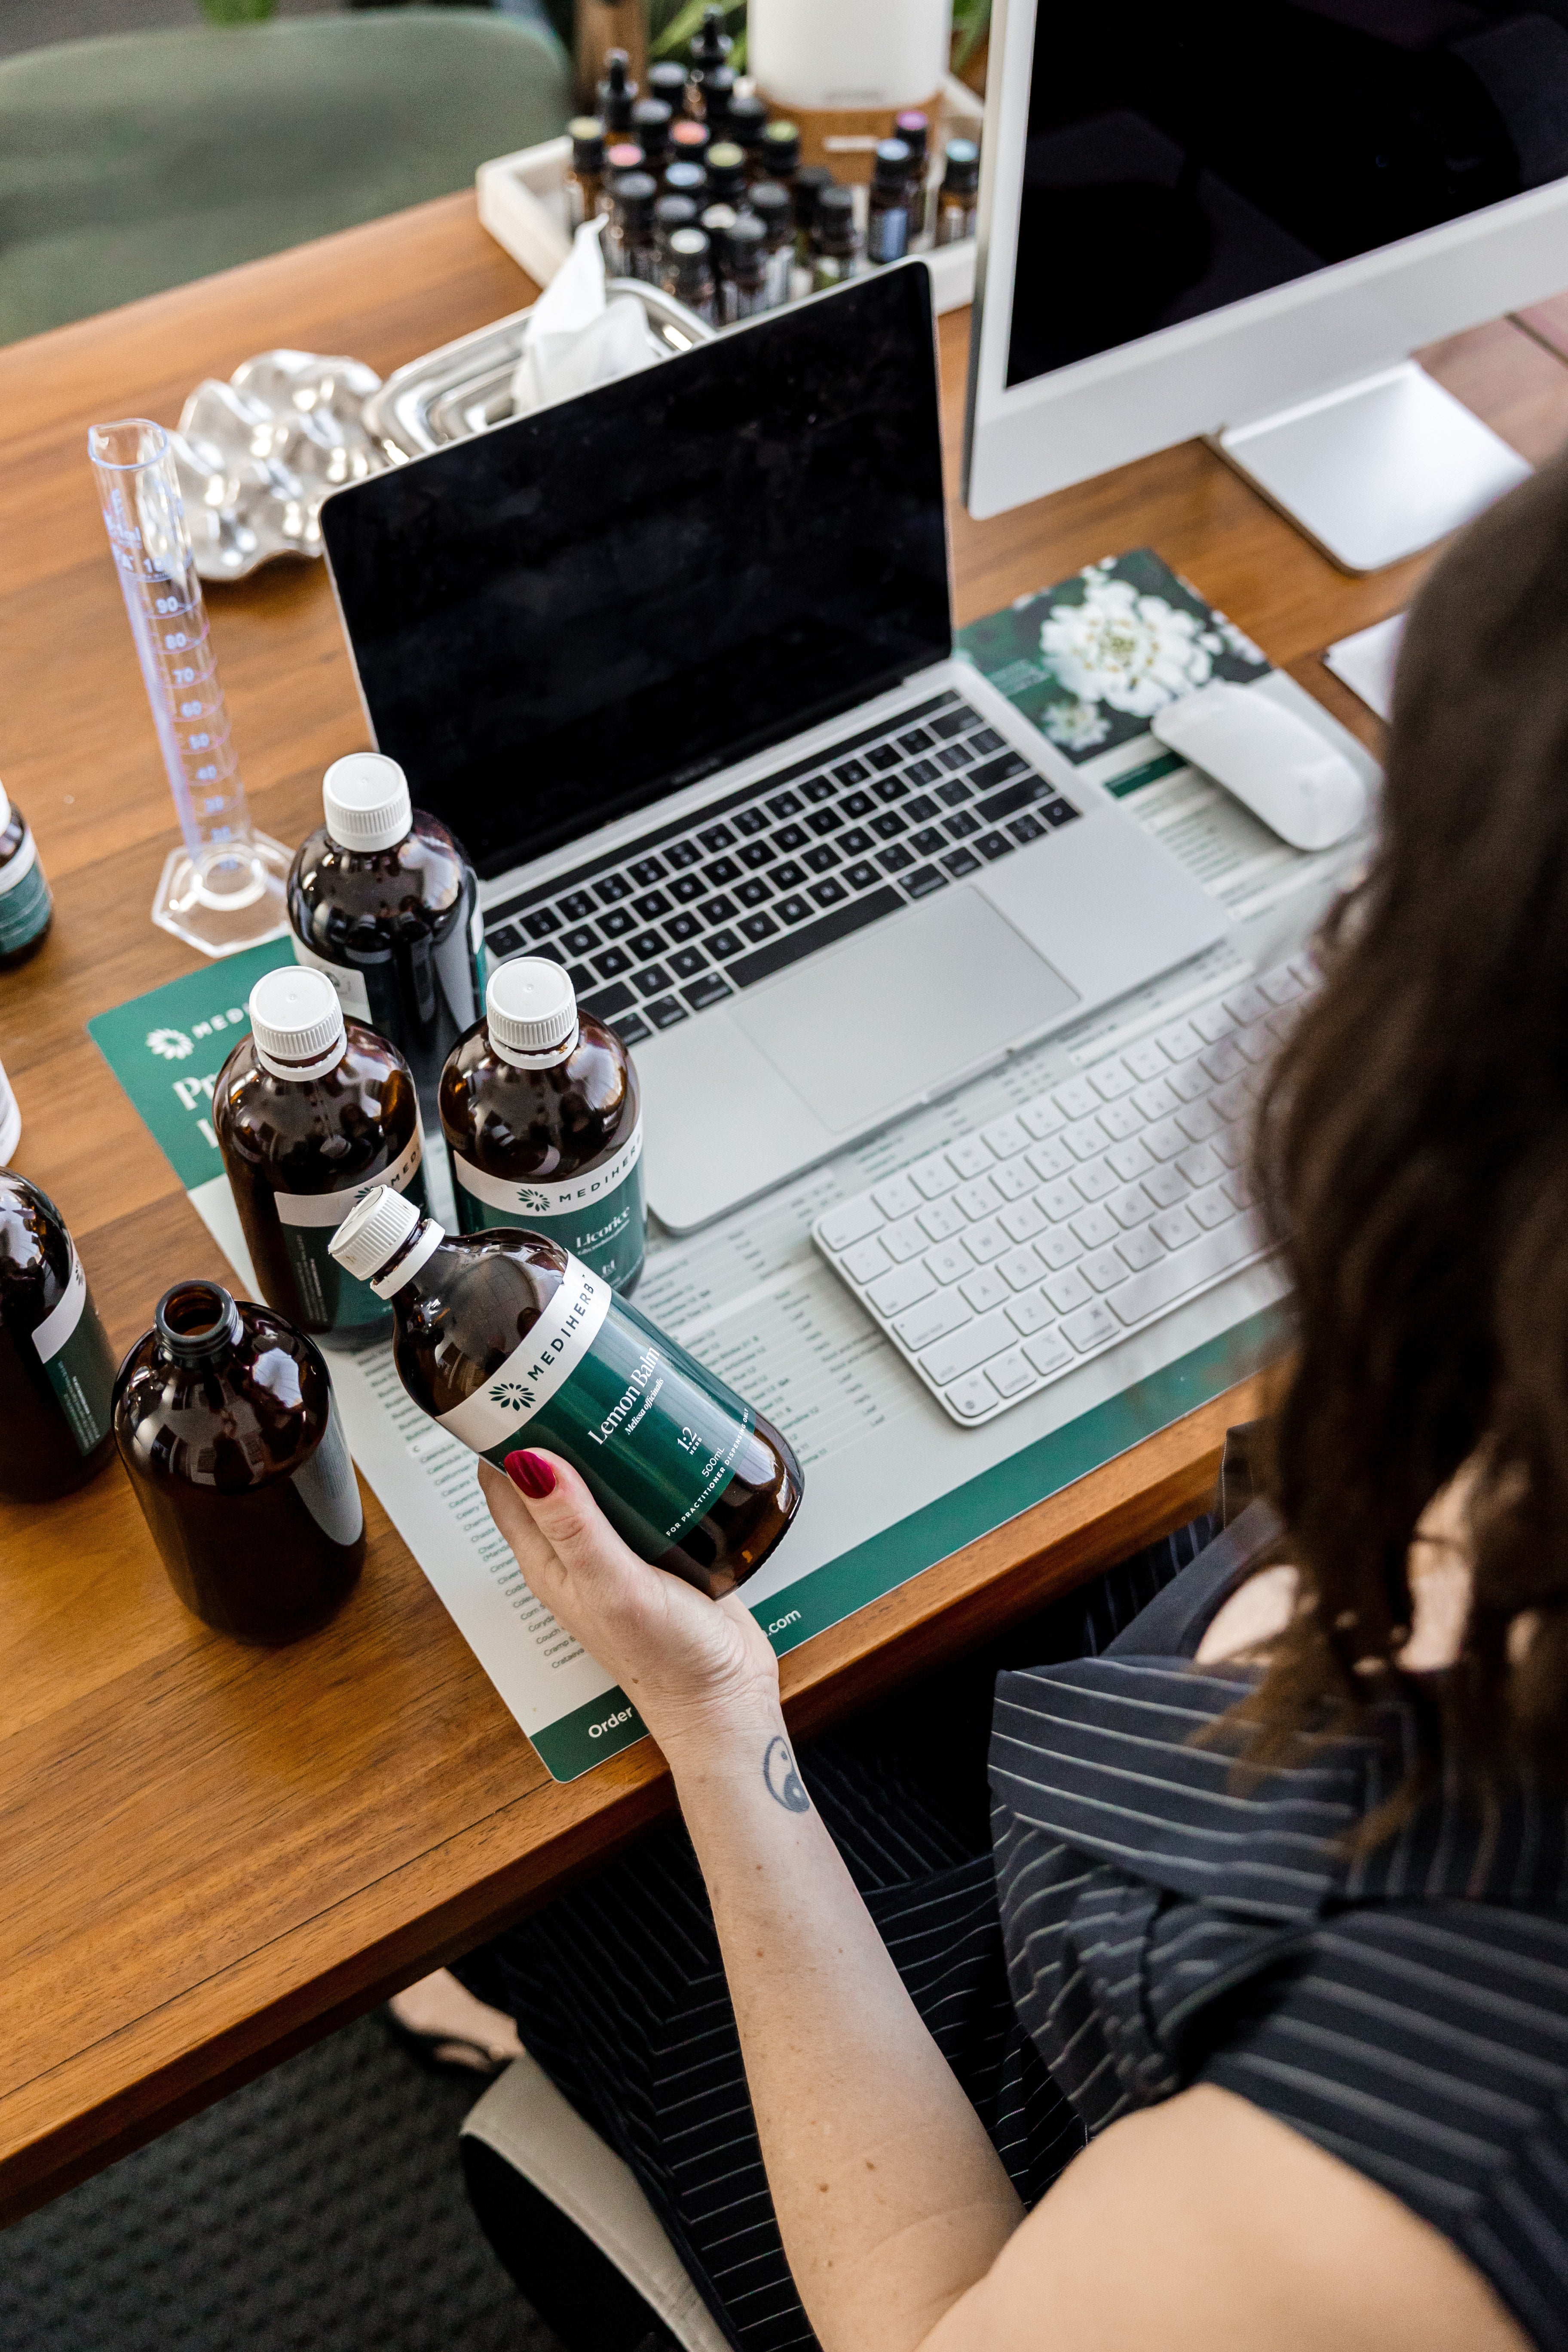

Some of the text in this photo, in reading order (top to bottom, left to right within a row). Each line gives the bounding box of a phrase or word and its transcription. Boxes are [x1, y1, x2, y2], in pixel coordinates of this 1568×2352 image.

[156, 596, 178, 614] 90
[173, 667, 194, 684] 70
[588, 1347, 660, 1445] Lemon Balm
[625, 1378, 664, 1436] Melissa officinalis
[677, 1427, 698, 1452] 1:2
[689, 1437, 702, 1455] HERB
[702, 1447, 725, 1477] 500mL
[666, 1522, 681, 1537] FOR
[681, 1467, 726, 1522] PRACTITIONER
[724, 1424, 746, 1466] DISPENSING
[763, 1610, 802, 1637] .com
[588, 1707, 632, 1738] Order
